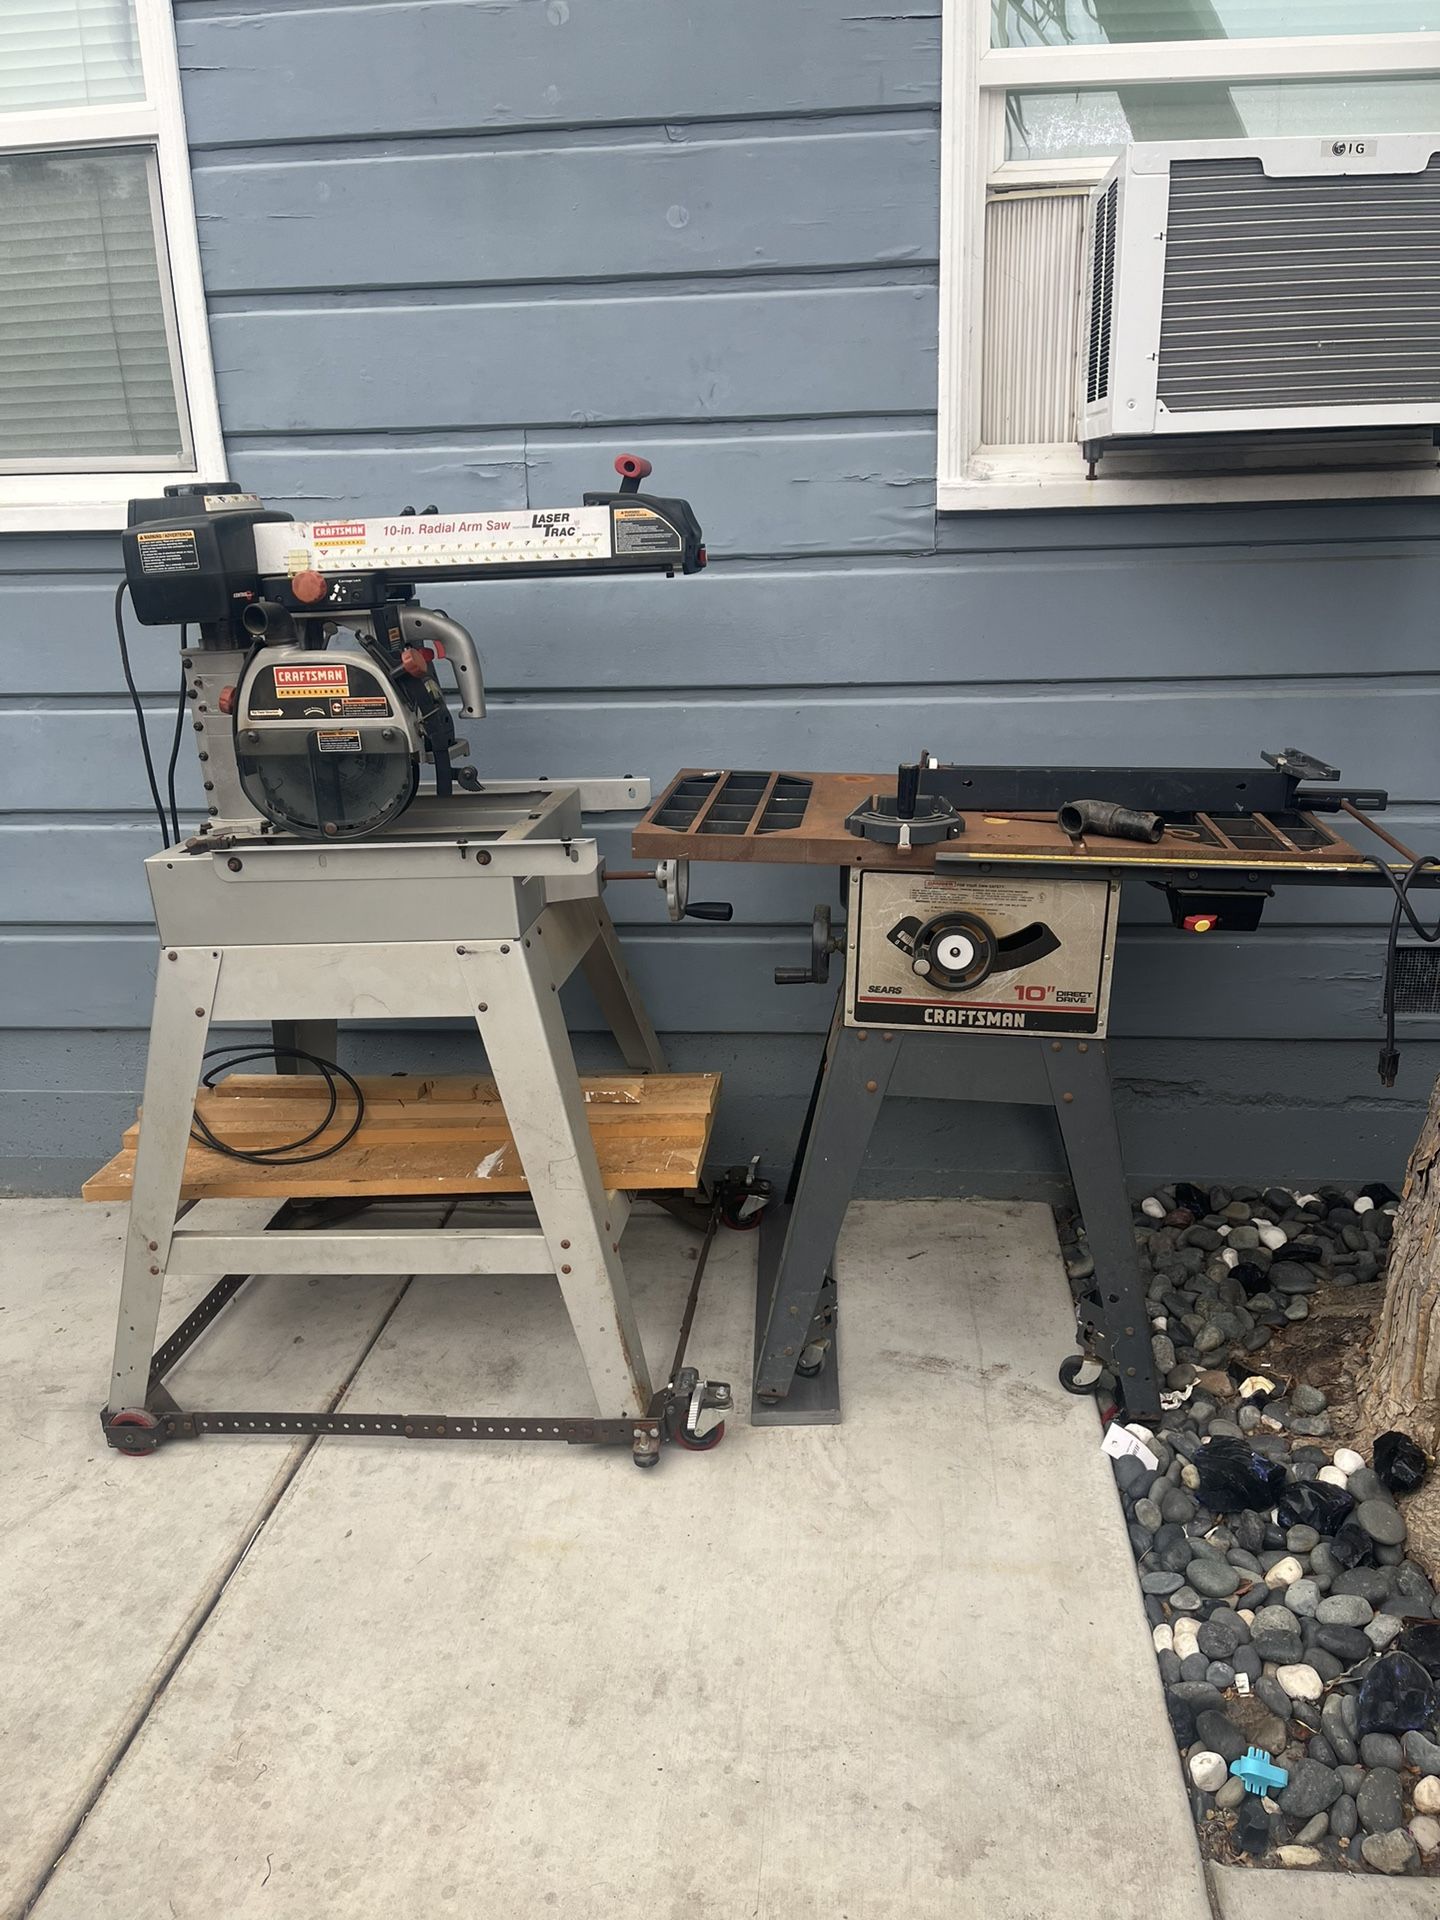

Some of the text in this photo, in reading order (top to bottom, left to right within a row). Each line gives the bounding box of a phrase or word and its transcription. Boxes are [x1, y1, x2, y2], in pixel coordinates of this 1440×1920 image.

[532, 513, 570, 529] LASER
[315, 526, 364, 537] CRAFTSMAN
[384, 520, 511, 537] 10-in. Radial Arm Saw
[544, 524, 576, 537] TRAC
[278, 670, 343, 682] CRAFTSMAN
[867, 985, 902, 995] SEARS
[1056, 990, 1093, 999] DIRECT
[924, 1008, 1026, 1028] CRAFTSMAN
